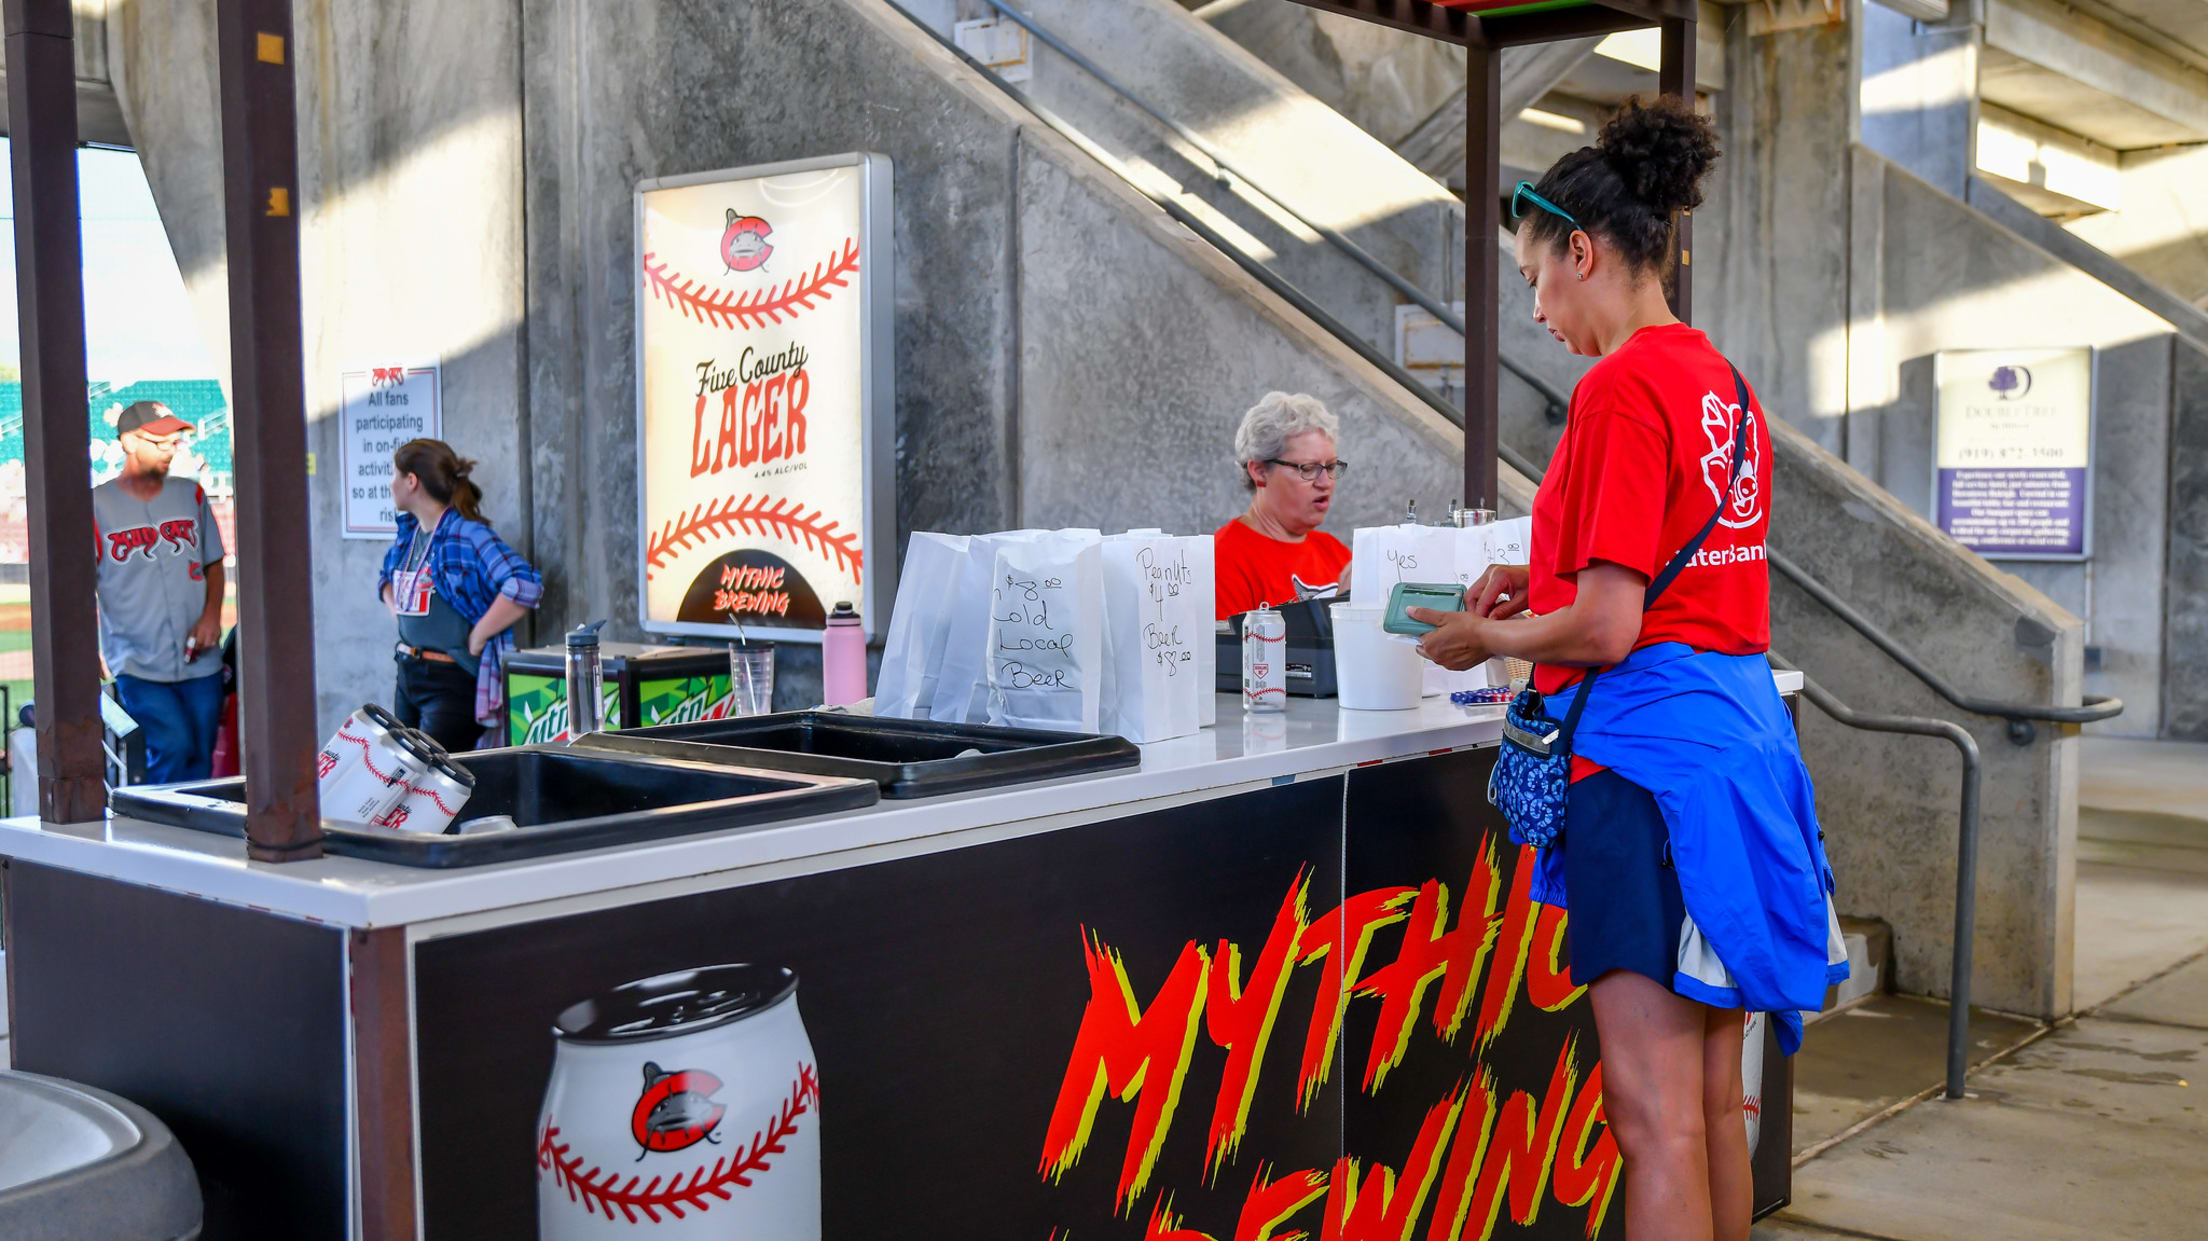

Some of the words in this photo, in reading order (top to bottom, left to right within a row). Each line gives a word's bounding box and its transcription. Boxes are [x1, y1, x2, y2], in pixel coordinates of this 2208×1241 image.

[696, 358, 737, 398] Five
[740, 341, 808, 378] County
[369, 391, 383, 406] All
[385, 390, 409, 406] fans
[356, 415, 423, 432] participating
[690, 369, 810, 479] LAGER
[363, 438, 373, 453] in
[358, 461, 393, 476] activit
[352, 487, 365, 499] so
[368, 485, 378, 499] at
[721, 564, 785, 590] MYTHIC
[713, 588, 790, 617] BREWING
[1038, 828, 1588, 1219] MYTHIC
